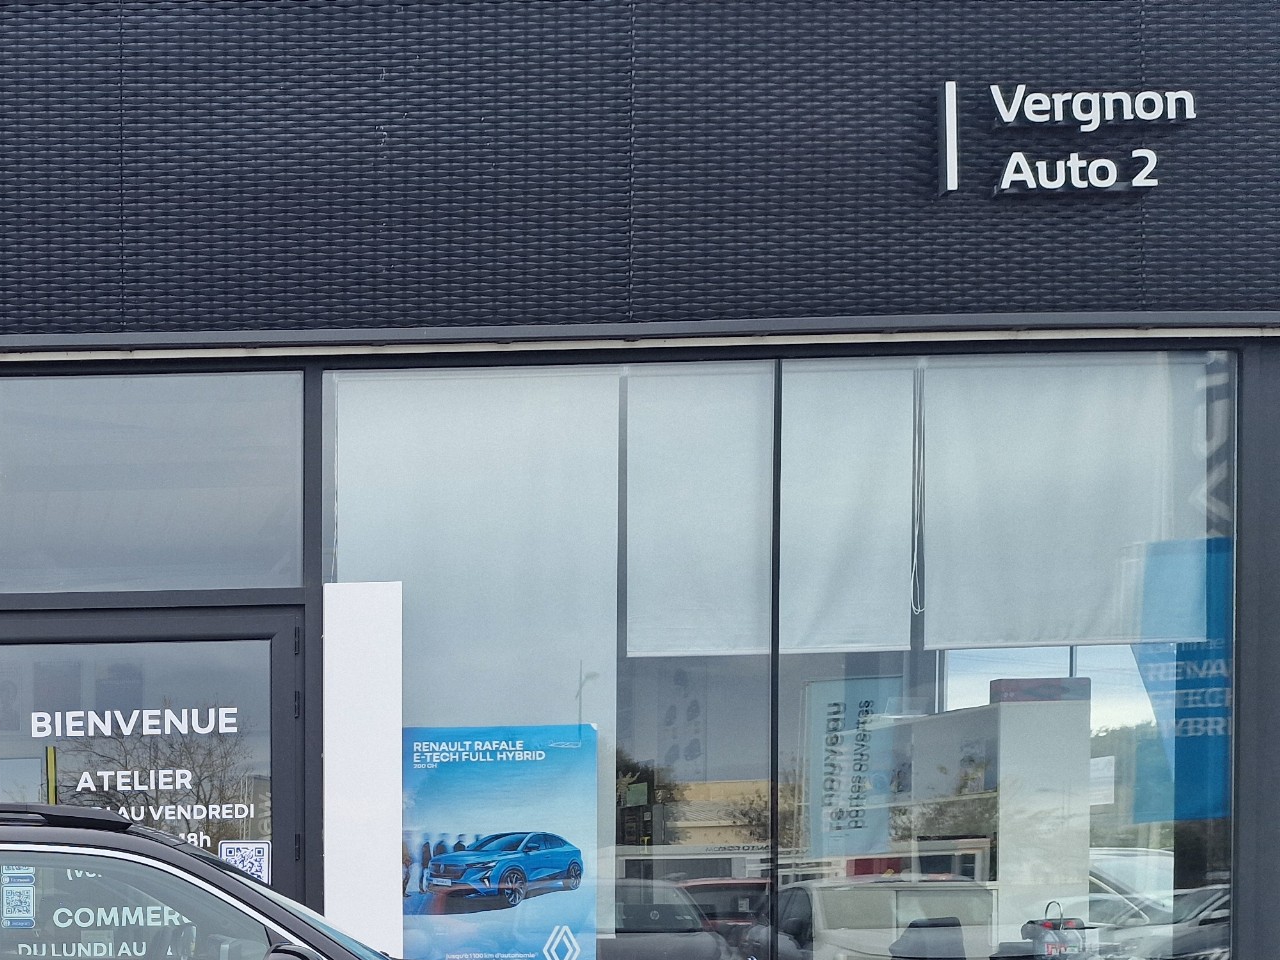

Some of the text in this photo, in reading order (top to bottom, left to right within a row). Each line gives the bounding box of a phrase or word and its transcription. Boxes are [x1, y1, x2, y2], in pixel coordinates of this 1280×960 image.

[990, 84, 1197, 132] Vergnon
[1000, 149, 1159, 189] Auto 2
[31, 707, 239, 738] BIENVENUE
[413, 740, 524, 752] RENAULT RAFALE
[413, 750, 546, 763] E-TECH FULL HYBRID
[76, 769, 193, 792] ATELIER
[117, 803, 254, 821] AU VENDREDI
[18, 942, 147, 957] DU LUNDI AU
